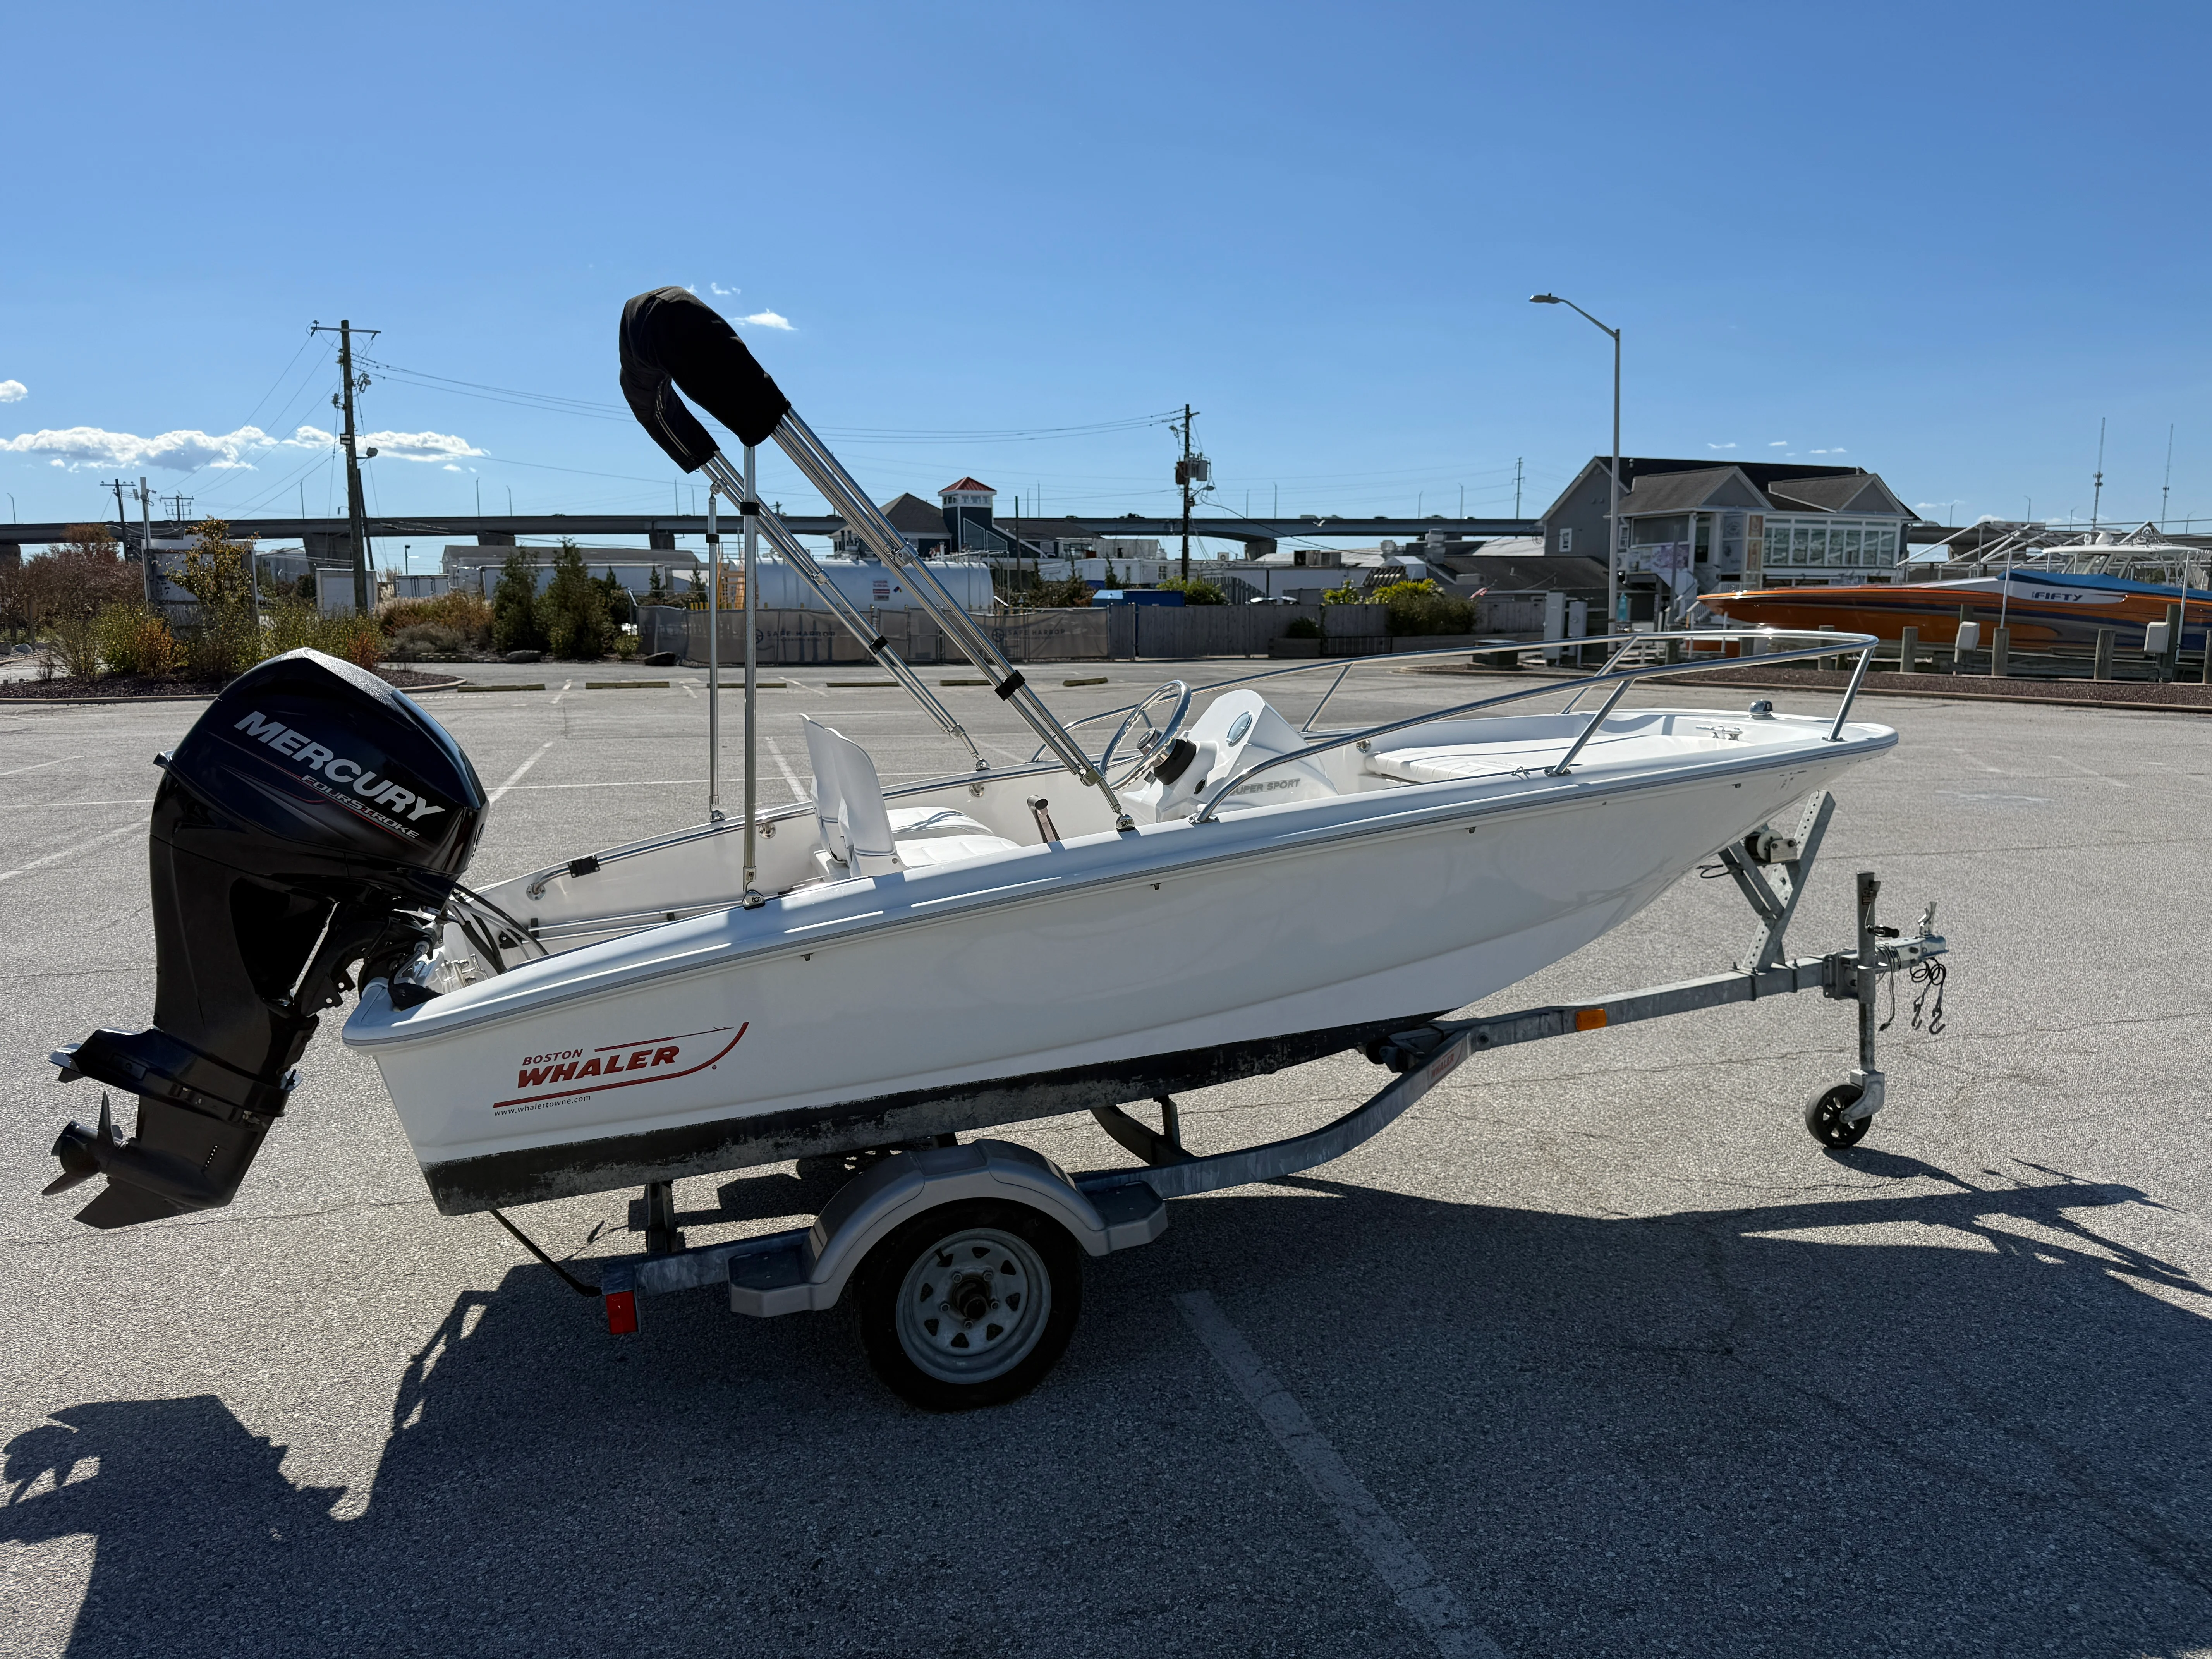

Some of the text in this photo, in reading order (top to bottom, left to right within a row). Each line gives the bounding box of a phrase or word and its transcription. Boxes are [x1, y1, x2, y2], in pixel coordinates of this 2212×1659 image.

[2034, 592, 2083, 601] FIFTY
[234, 711, 445, 822] MERCURY
[1267, 779, 1301, 791] SPORT
[301, 775, 420, 839] FOURSTROKE
[517, 1046, 680, 1089] WHALER
[522, 1048, 584, 1066] BOSTON
[1431, 1053, 1455, 1079] WHALER
[494, 1094, 591, 1116] www.whalertowne.com
